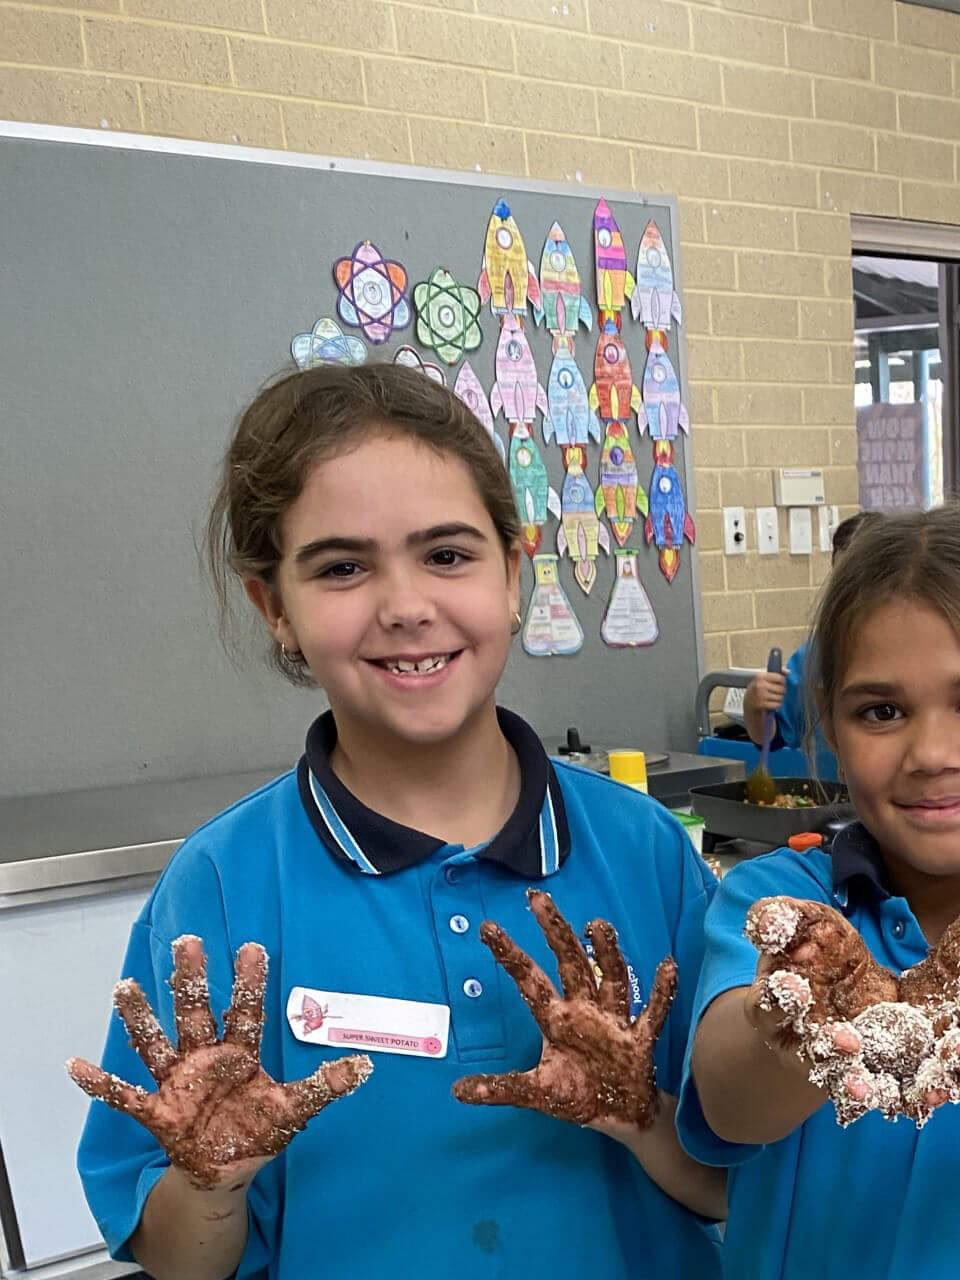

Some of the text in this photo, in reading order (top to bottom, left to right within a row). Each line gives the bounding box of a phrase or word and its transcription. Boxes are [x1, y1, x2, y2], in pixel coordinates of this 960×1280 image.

[343, 1032, 420, 1048] SUPER SWEET POTATO
